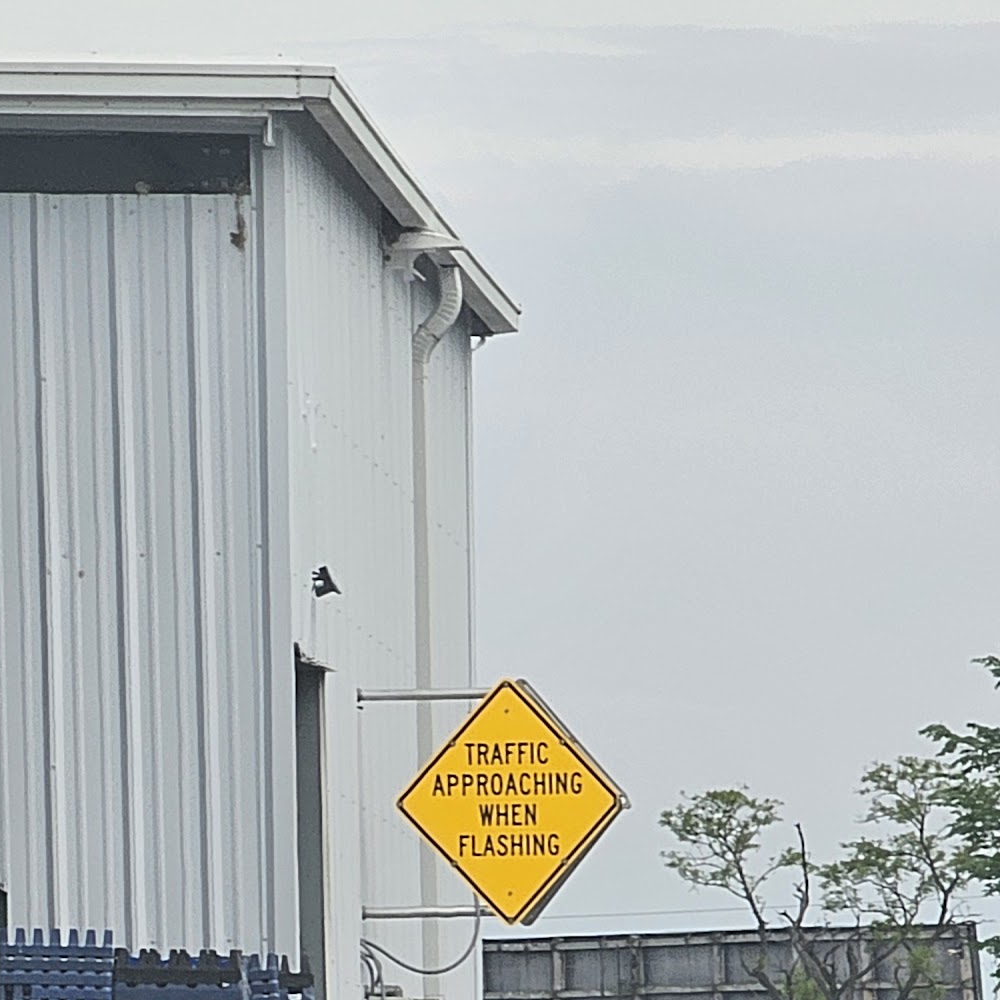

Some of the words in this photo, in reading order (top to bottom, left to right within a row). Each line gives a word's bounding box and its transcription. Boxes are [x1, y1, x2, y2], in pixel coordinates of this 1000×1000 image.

[464, 741, 549, 766] TRAFFIC
[432, 772, 583, 797] APPROACHING
[479, 803, 537, 827] WHEN
[458, 833, 560, 858] FLASHING
